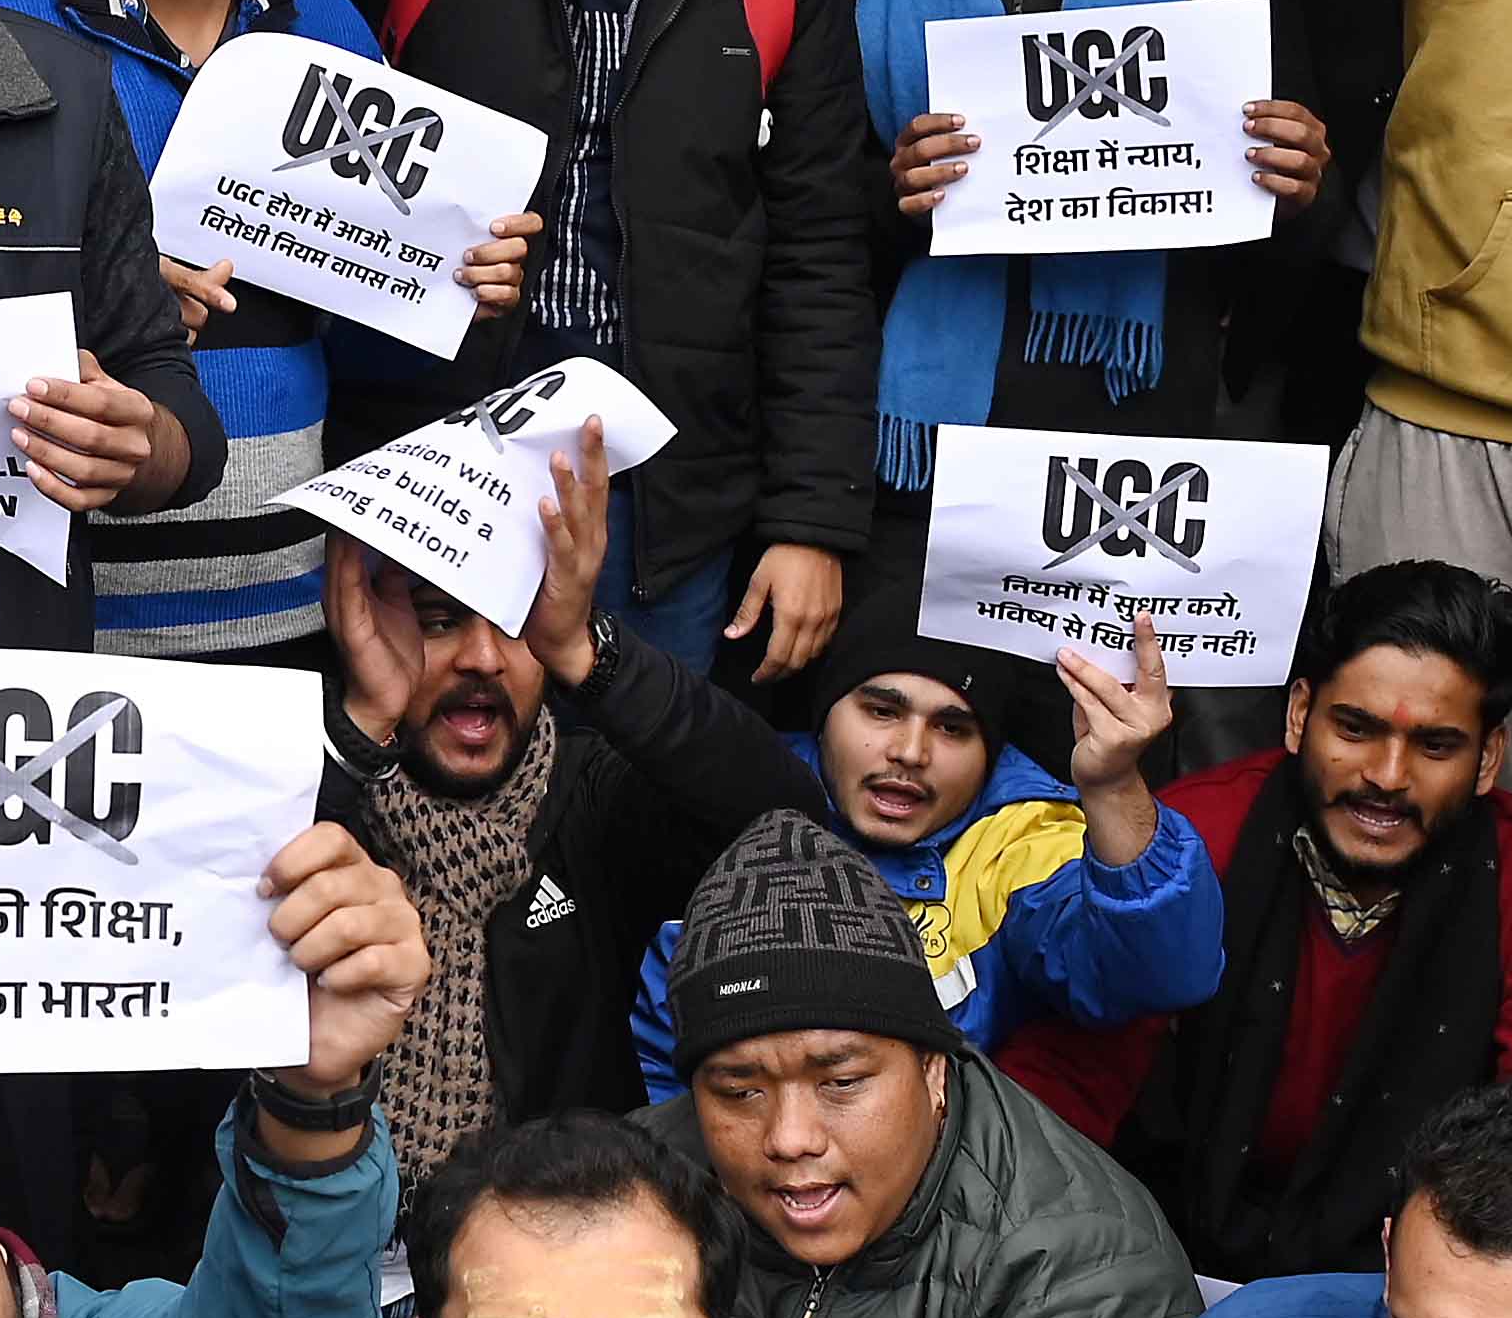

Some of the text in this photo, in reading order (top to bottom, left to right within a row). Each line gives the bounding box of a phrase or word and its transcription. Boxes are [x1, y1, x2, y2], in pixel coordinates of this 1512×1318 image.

[1022, 26, 1168, 122] UGC
[282, 63, 443, 201] UGC
[1005, 187, 1213, 225] देश का विकास!
[199, 204, 427, 306] विरोधी नियम वापस लो!
[304, 479, 471, 569] strong nation!
[1043, 456, 1209, 558] UGC
[1002, 574, 1242, 623] नियमों में सुधार करो,
[40, 888, 183, 947] शिक्षा,
[526, 897, 576, 930] adidas
[39, 982, 171, 1020] भारत!
